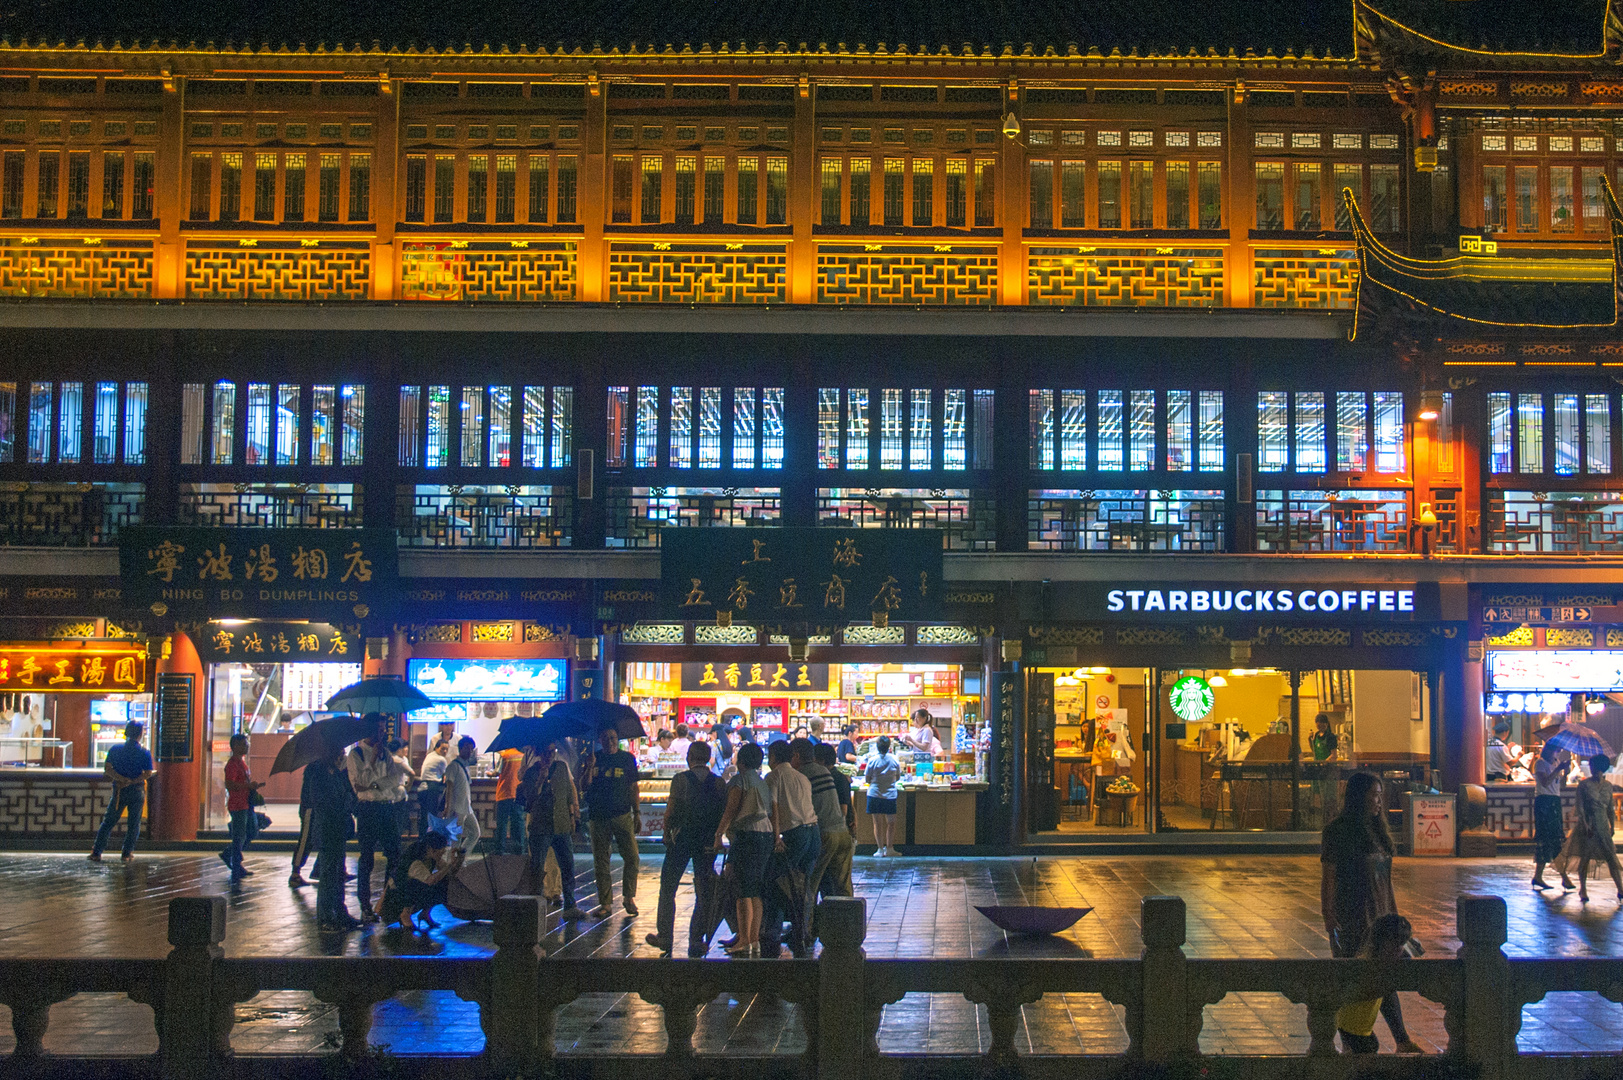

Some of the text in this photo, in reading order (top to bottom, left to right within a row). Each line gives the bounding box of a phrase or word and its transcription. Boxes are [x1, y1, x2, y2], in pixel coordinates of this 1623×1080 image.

[741, 537, 864, 567] 上海
[162, 589, 359, 601] NING BO DUMPLINGS
[678, 573, 902, 610] 五香豆商店
[1106, 589, 1415, 612] STARBUCKS COFFEE
[17, 656, 137, 686] 手工湯圓
[699, 662, 812, 689] 五香豆大王
